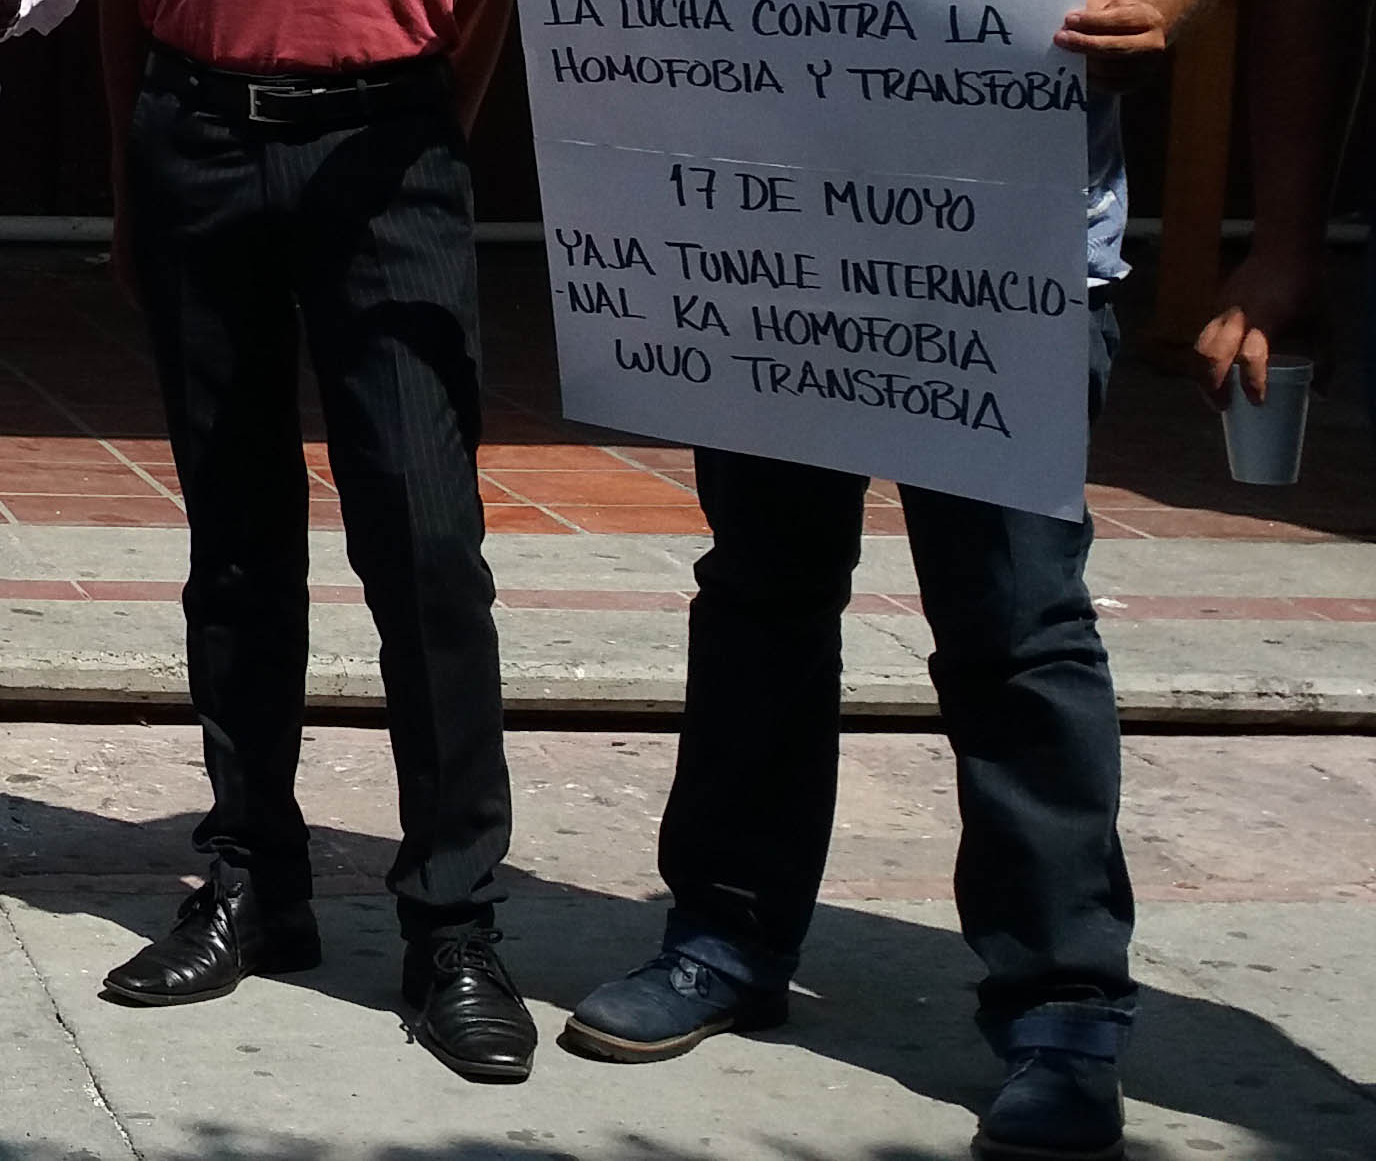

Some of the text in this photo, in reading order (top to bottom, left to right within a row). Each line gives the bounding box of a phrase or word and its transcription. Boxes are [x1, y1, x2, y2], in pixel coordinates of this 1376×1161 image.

[753, 0, 916, 44] CONTRA
[945, 5, 1012, 45] LA
[552, 49, 784, 94] HOMOFOBIA
[807, 60, 833, 100] Y
[669, 164, 975, 232] 17 DE MUOYO
[556, 229, 656, 276] YAJA
[665, 241, 820, 290] TUNALE
[673, 295, 730, 337] KA
[754, 305, 997, 374] HOMOFOBIA
[615, 339, 1013, 439] WUO TRANSFOBIA
